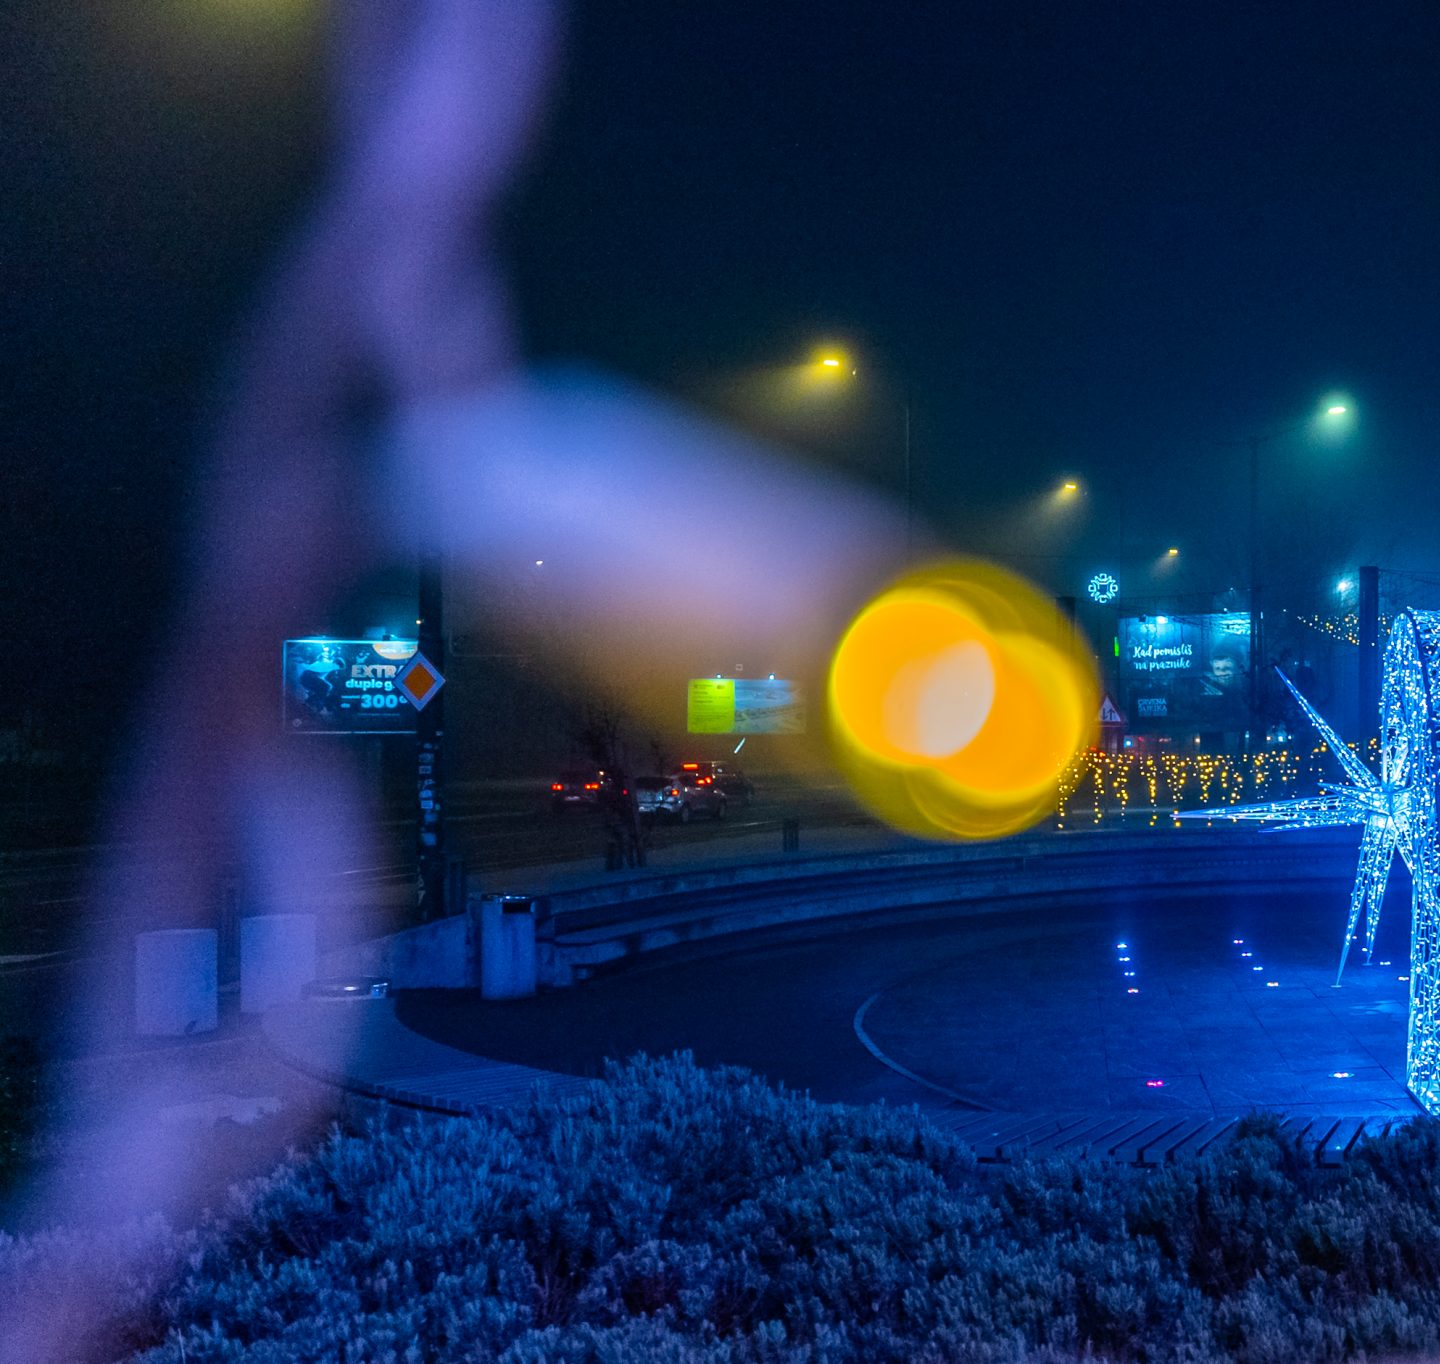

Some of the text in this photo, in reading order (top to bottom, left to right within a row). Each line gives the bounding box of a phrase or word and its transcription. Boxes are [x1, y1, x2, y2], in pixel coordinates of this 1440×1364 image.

[1132, 643, 1193, 659] Kad pomisliš
[1133, 657, 1192, 672] na praznike
[345, 678, 383, 692] duple
